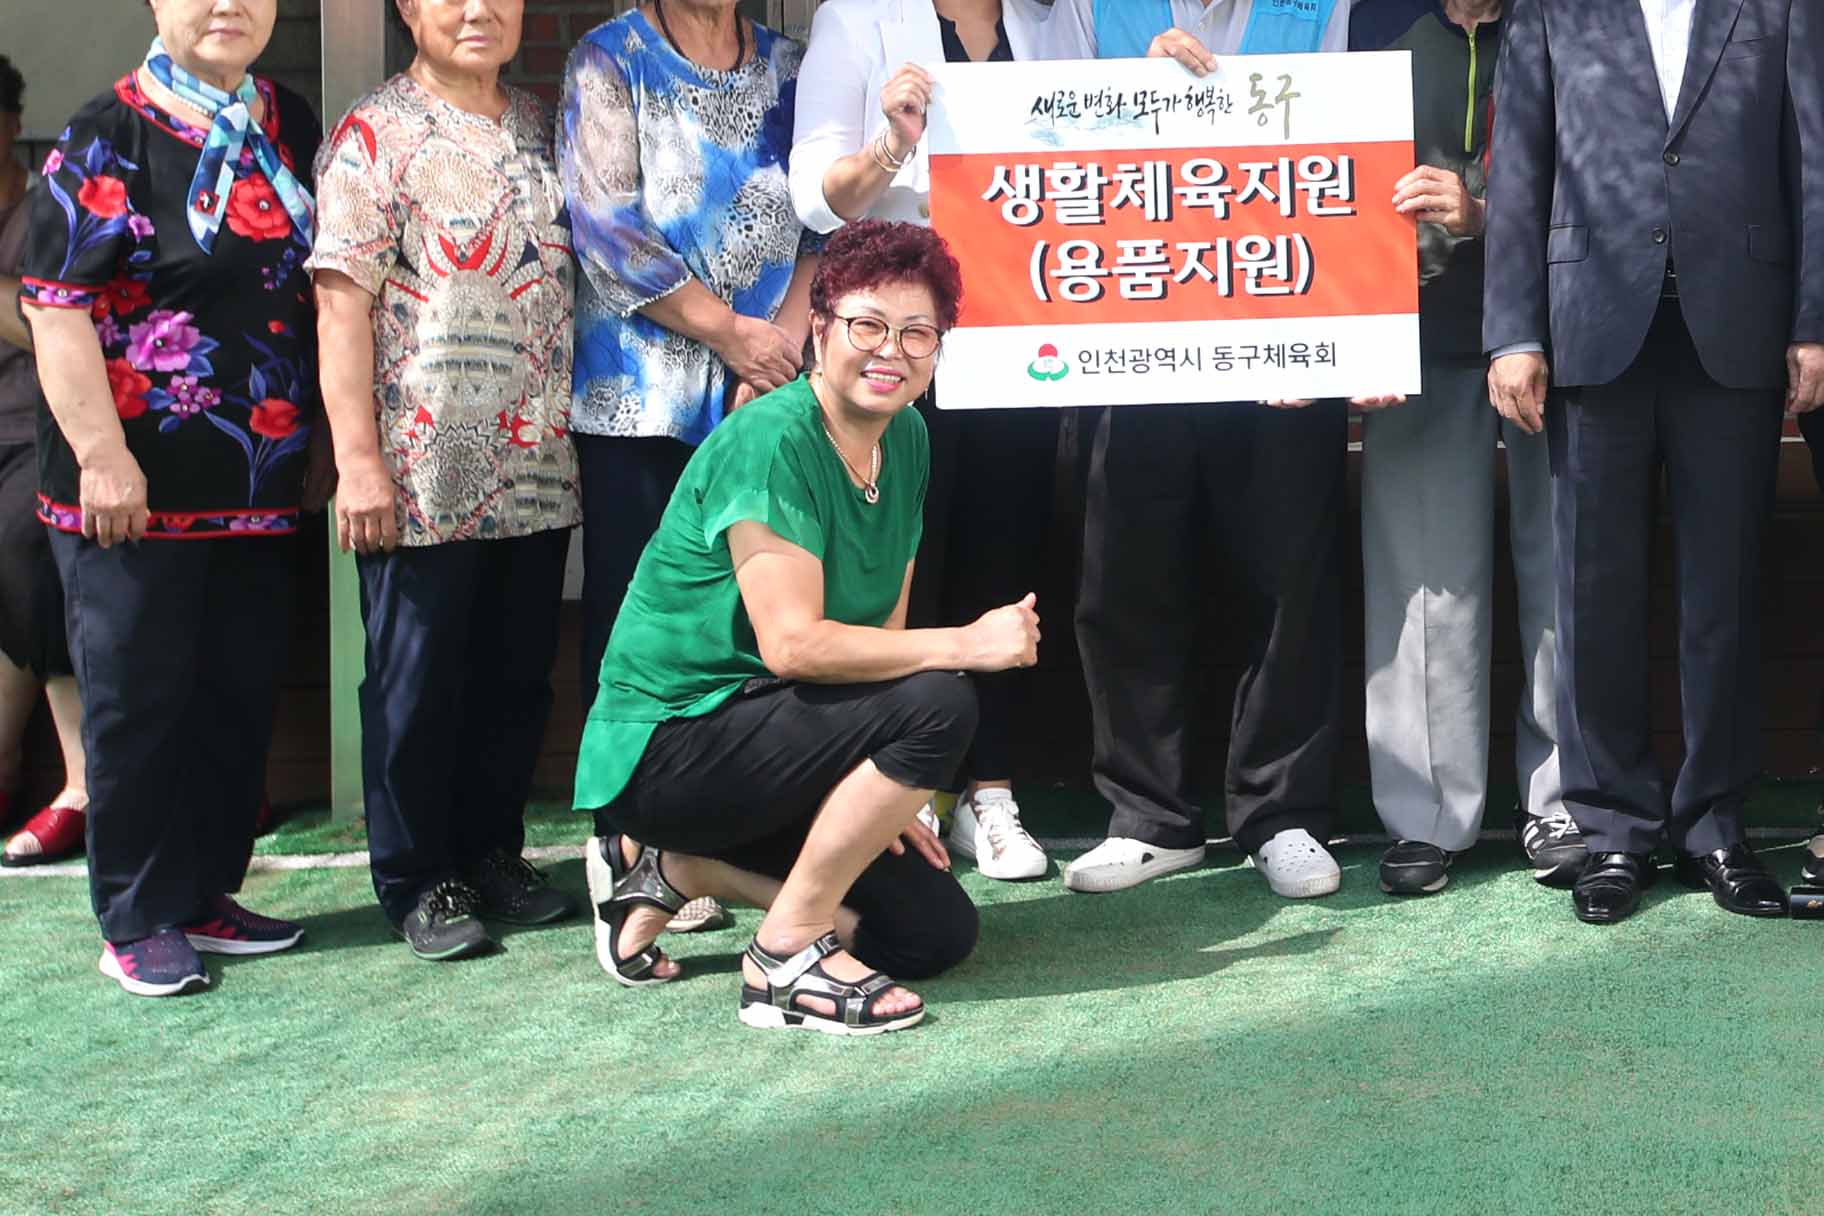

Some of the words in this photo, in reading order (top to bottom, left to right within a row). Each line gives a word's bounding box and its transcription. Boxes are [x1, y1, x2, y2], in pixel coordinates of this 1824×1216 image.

[1030, 89, 1083, 126] 새로운
[1084, 86, 1127, 119] 변화
[1133, 90, 1182, 135] 모두가
[1184, 85, 1234, 126] 행복한
[1247, 72, 1301, 140] 동구
[982, 154, 1358, 228] 생활체육지원
[1029, 232, 1316, 303] (용품지원)
[1077, 343, 1203, 376] 인천광역시
[1211, 340, 1338, 370] 동구체육회
